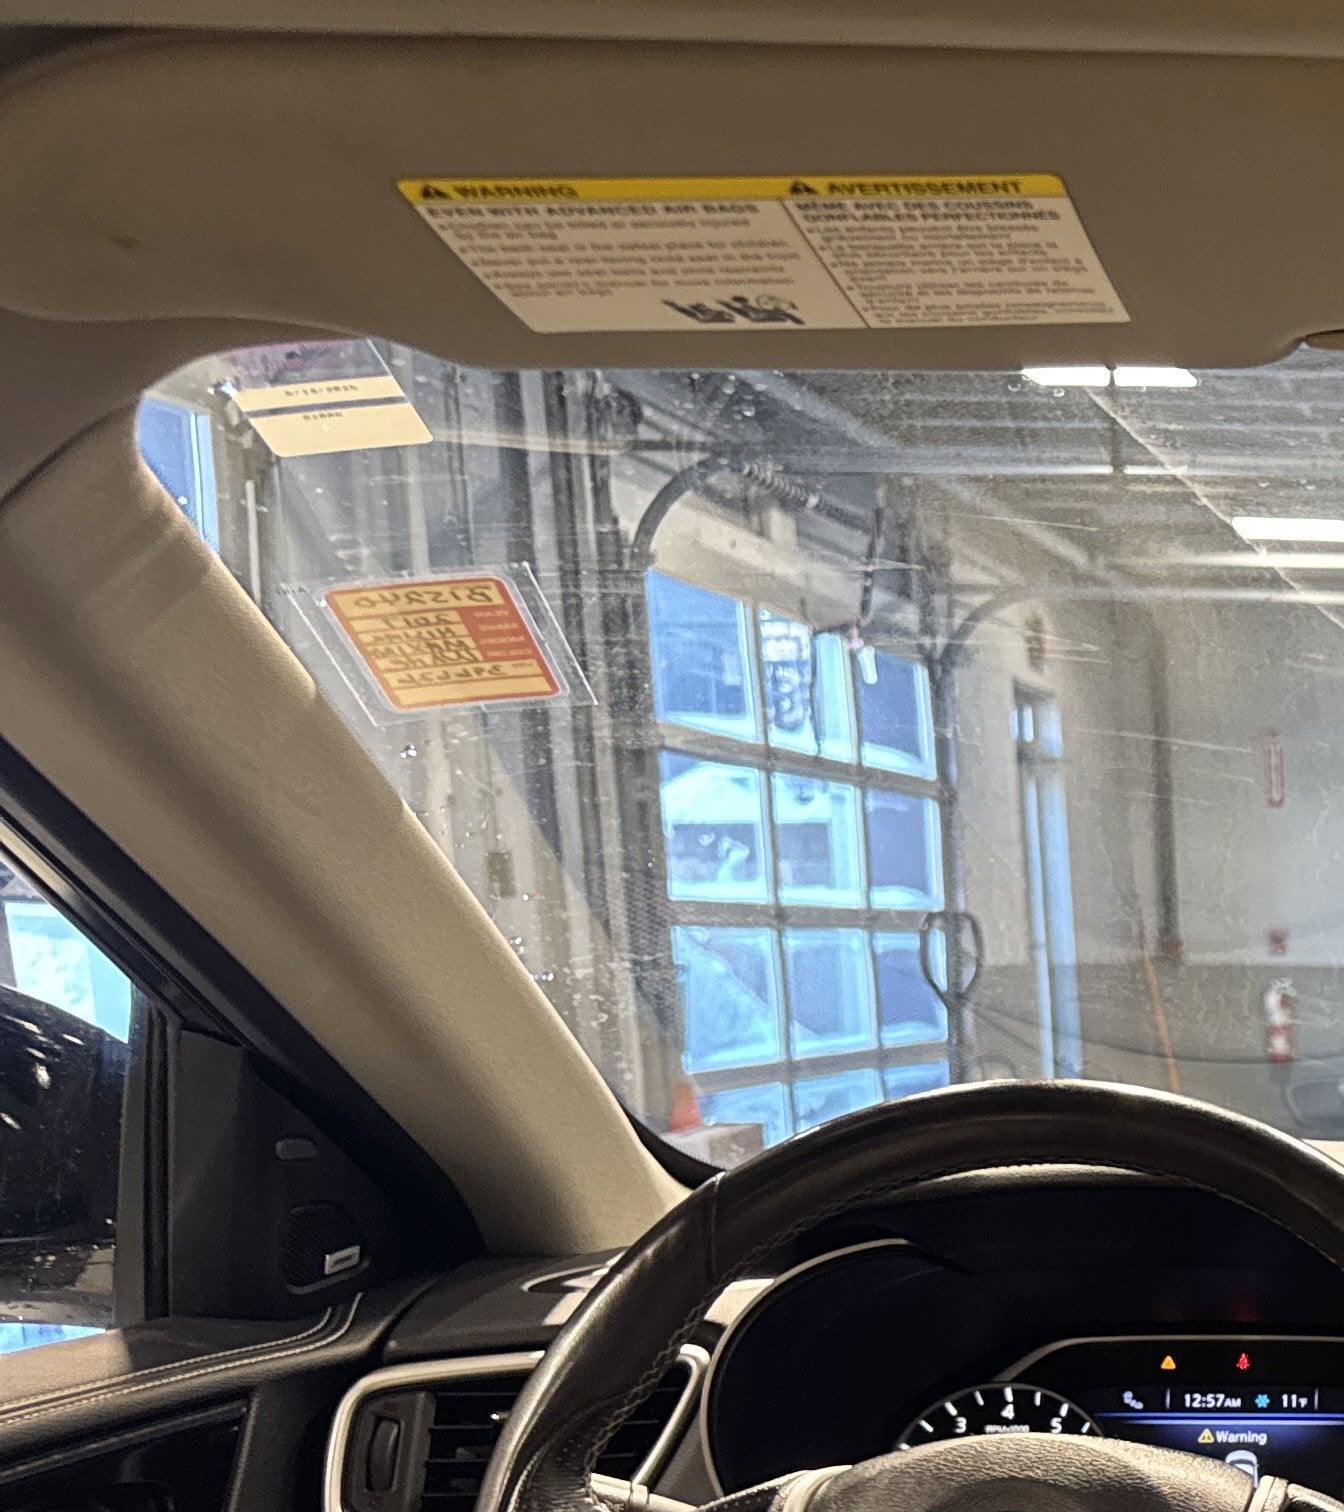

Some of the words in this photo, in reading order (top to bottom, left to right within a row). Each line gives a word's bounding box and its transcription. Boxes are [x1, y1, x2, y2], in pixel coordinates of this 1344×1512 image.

[452, 184, 578, 198] WARNING
[827, 181, 1021, 195] AVERTISSEMENT
[1000, 1403, 1015, 1420] 4
[955, 1417, 967, 1433] 3
[1050, 1417, 1062, 1433] 5
[1216, 1429, 1268, 1446] Warning
